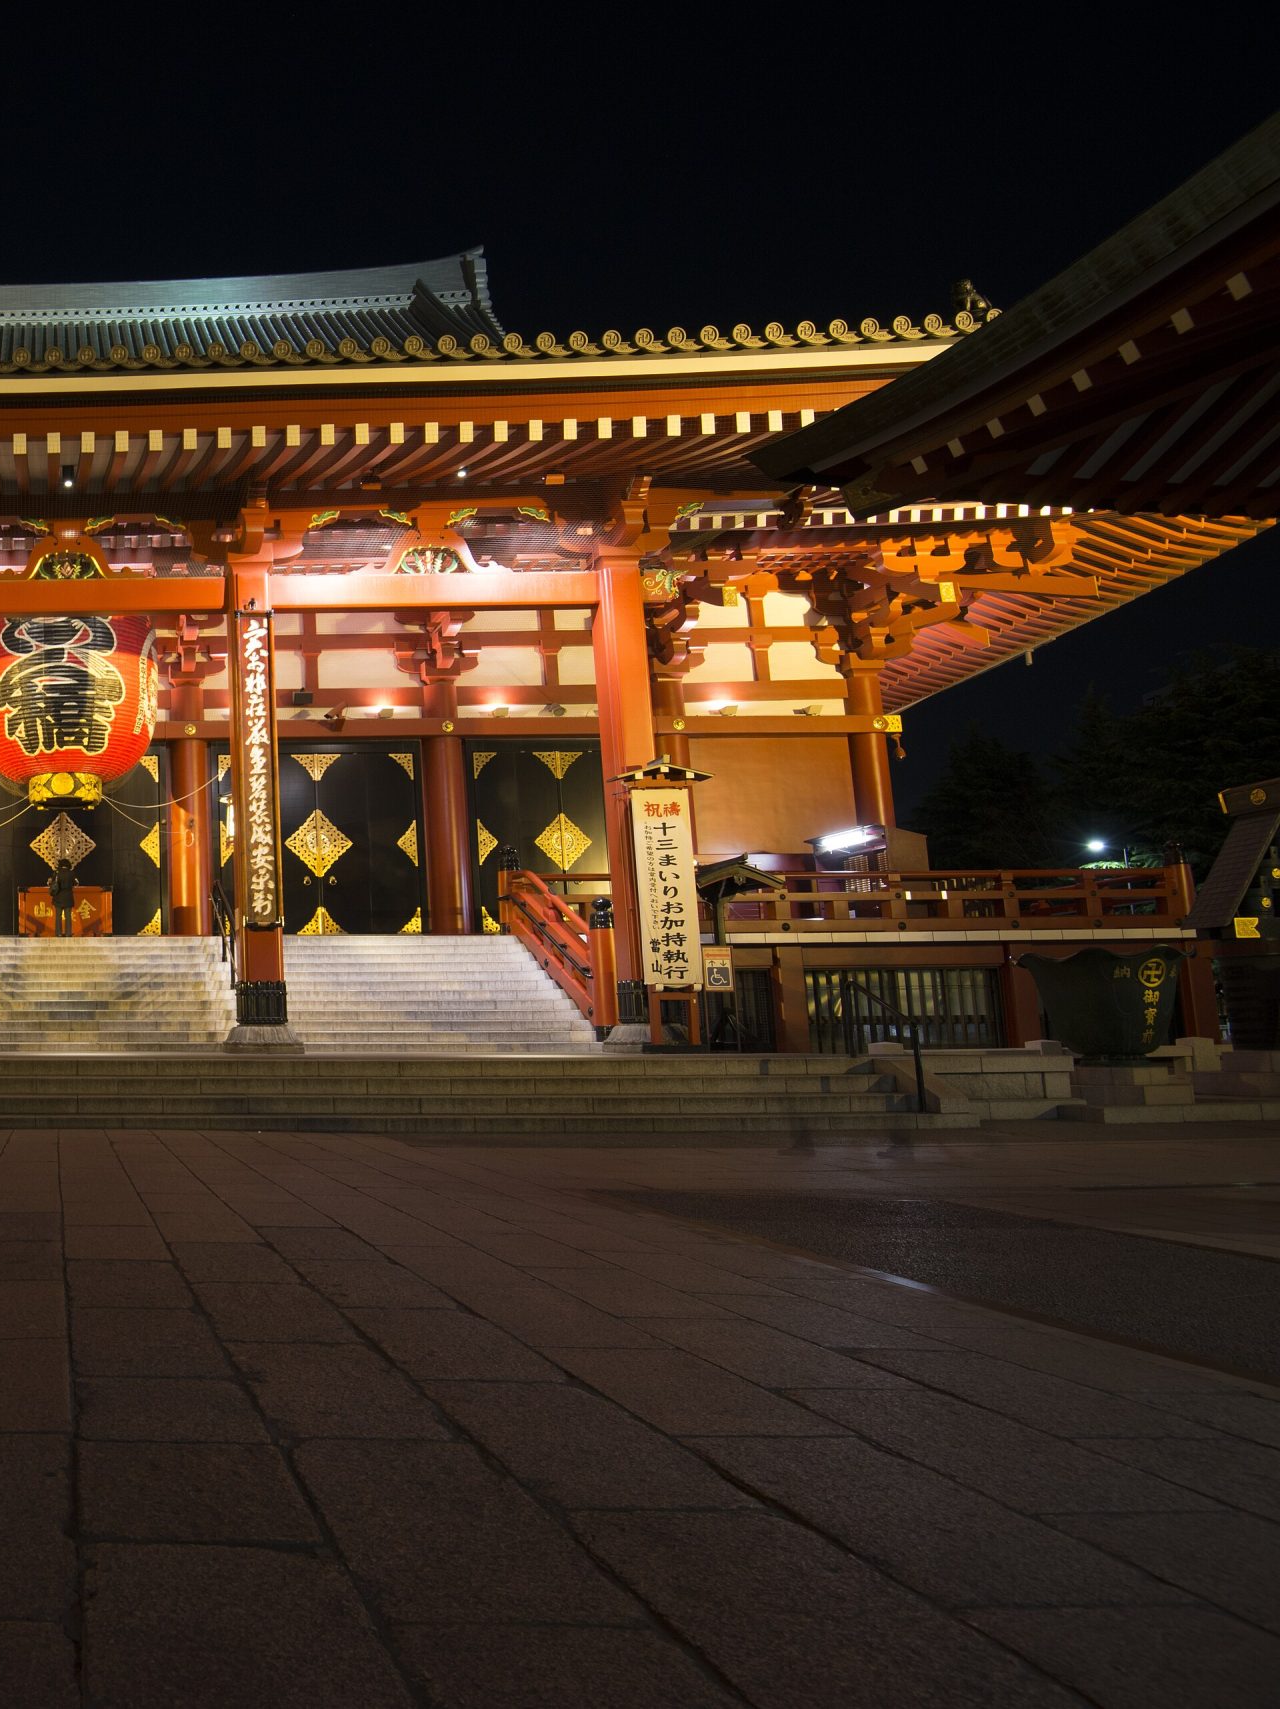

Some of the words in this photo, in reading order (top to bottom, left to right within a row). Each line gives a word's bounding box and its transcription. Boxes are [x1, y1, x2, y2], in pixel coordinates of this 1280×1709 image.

[653, 822, 690, 980] 十三まいりお加持執行
[649, 937, 663, 975] 當山
